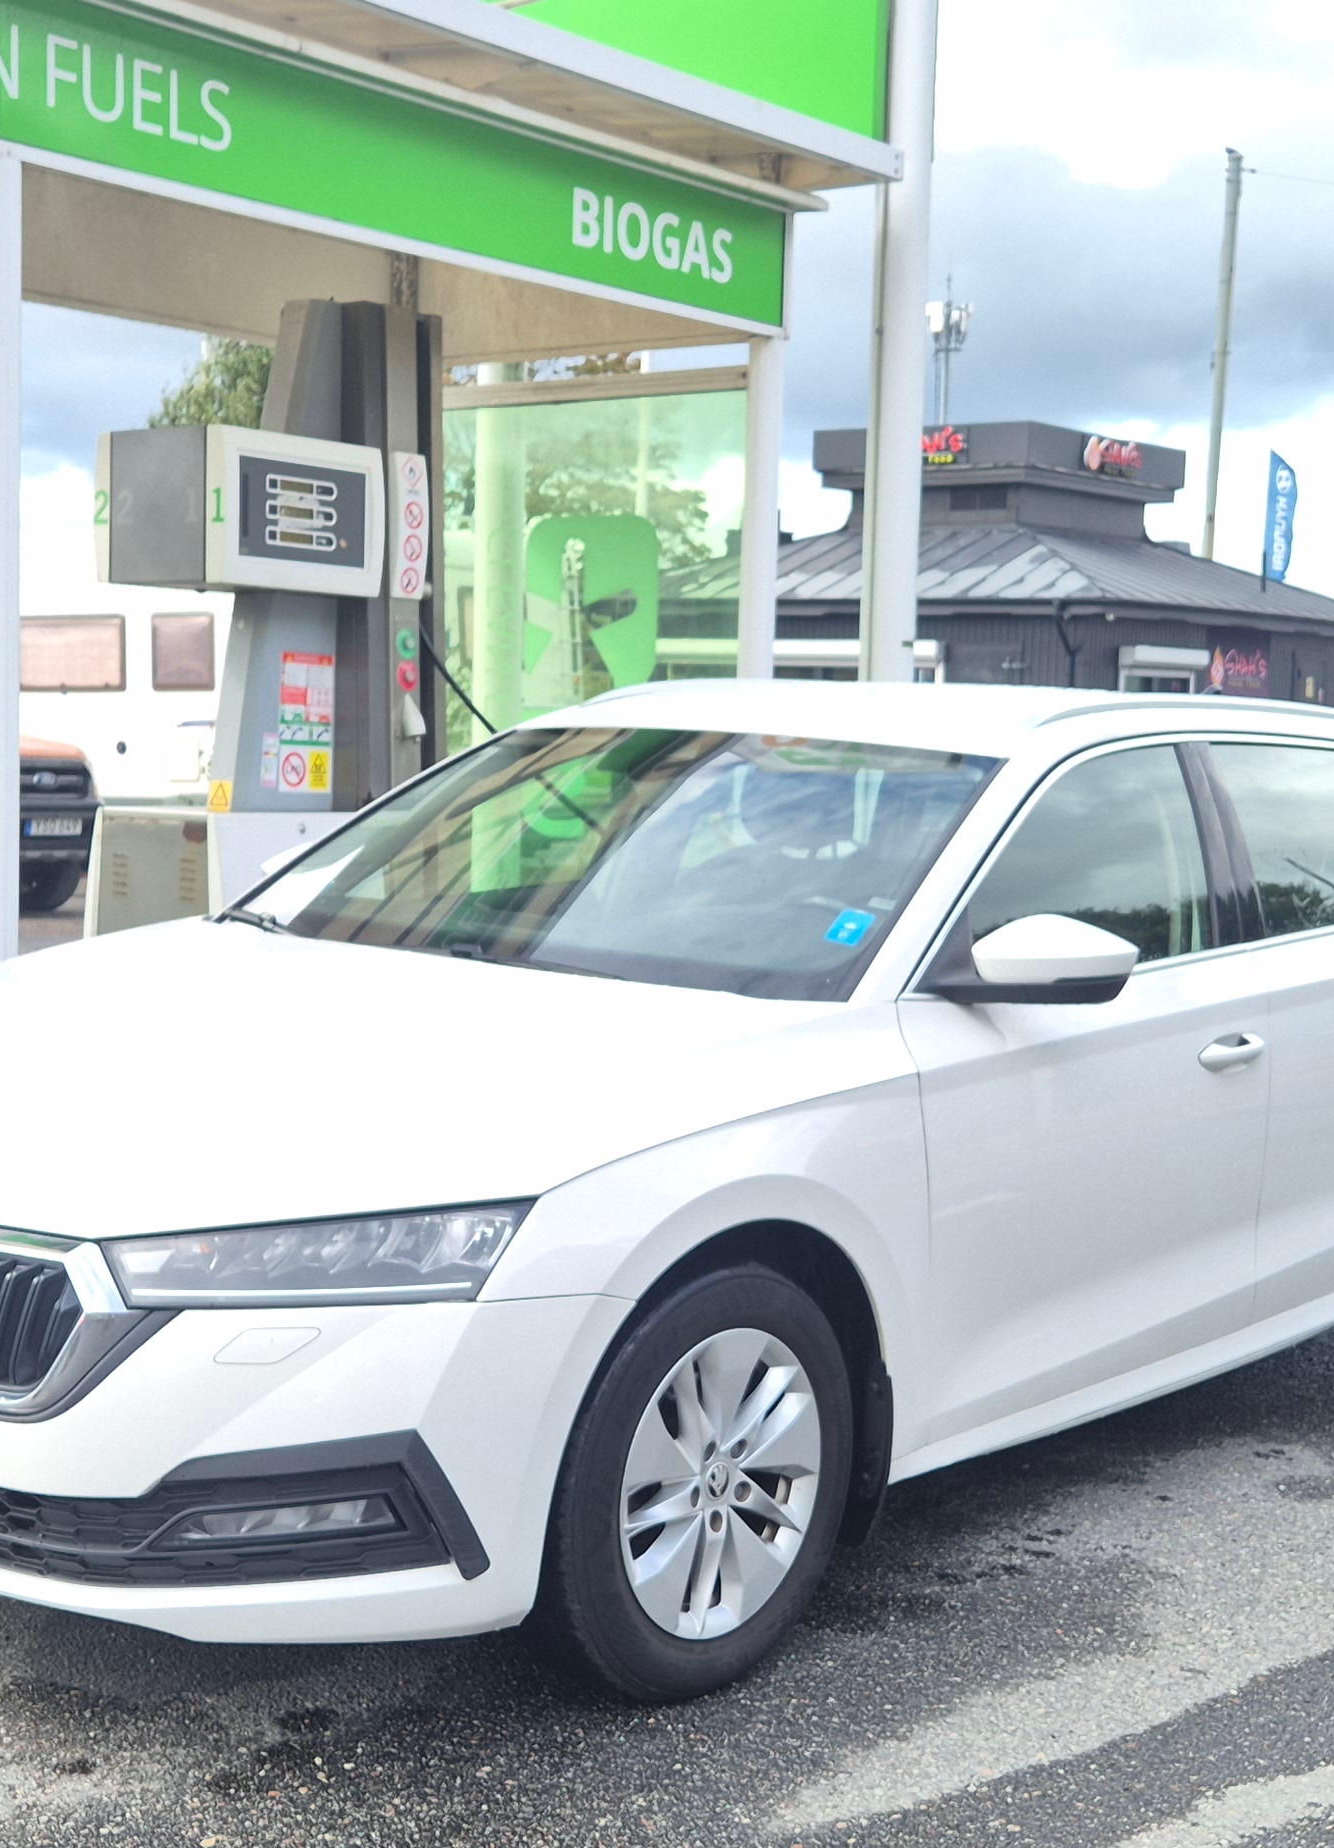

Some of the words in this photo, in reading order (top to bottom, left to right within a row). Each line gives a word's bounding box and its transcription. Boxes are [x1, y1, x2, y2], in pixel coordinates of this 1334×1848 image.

[45, 34, 233, 152] FUELS
[571, 186, 733, 284] BIOGAS
[93, 489, 109, 525] 2
[211, 487, 225, 523] 1
